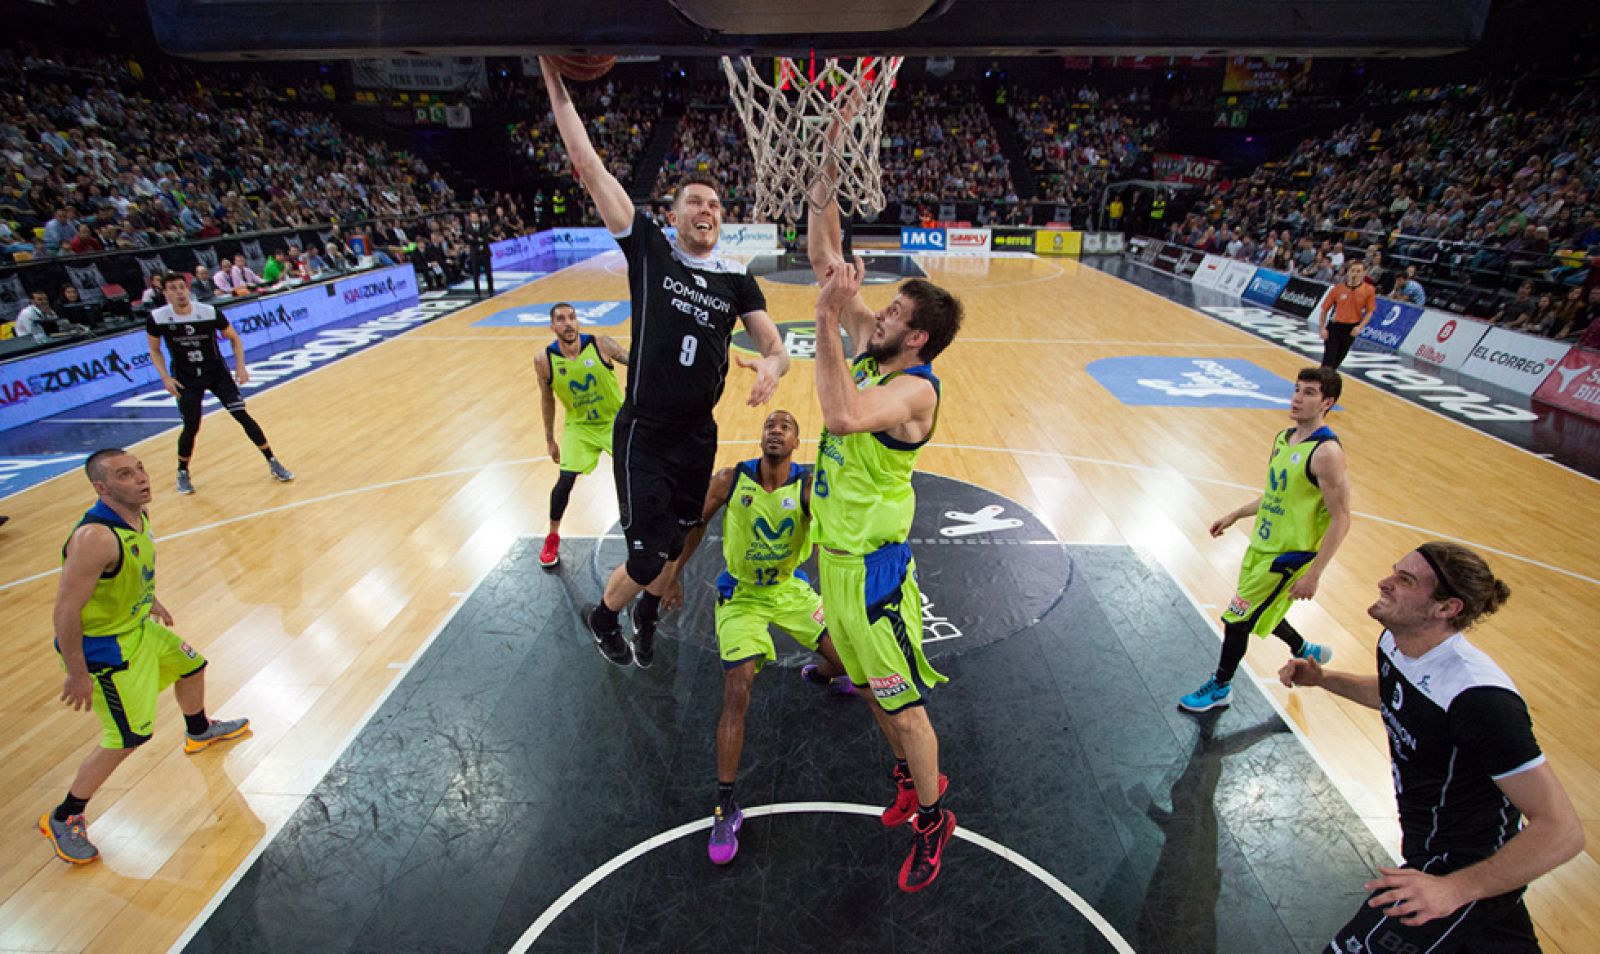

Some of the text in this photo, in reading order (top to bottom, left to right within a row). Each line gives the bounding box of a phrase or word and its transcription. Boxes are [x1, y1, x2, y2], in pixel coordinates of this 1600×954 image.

[902, 232, 942, 247] IMQ
[662, 275, 730, 313] DOMINION
[1359, 326, 1401, 347] OMINION
[679, 334, 697, 366] 9
[1414, 343, 1446, 364] Bilbao
[1473, 345, 1490, 360] EL
[1489, 350, 1545, 375] CORREO
[755, 568, 780, 586] 12
